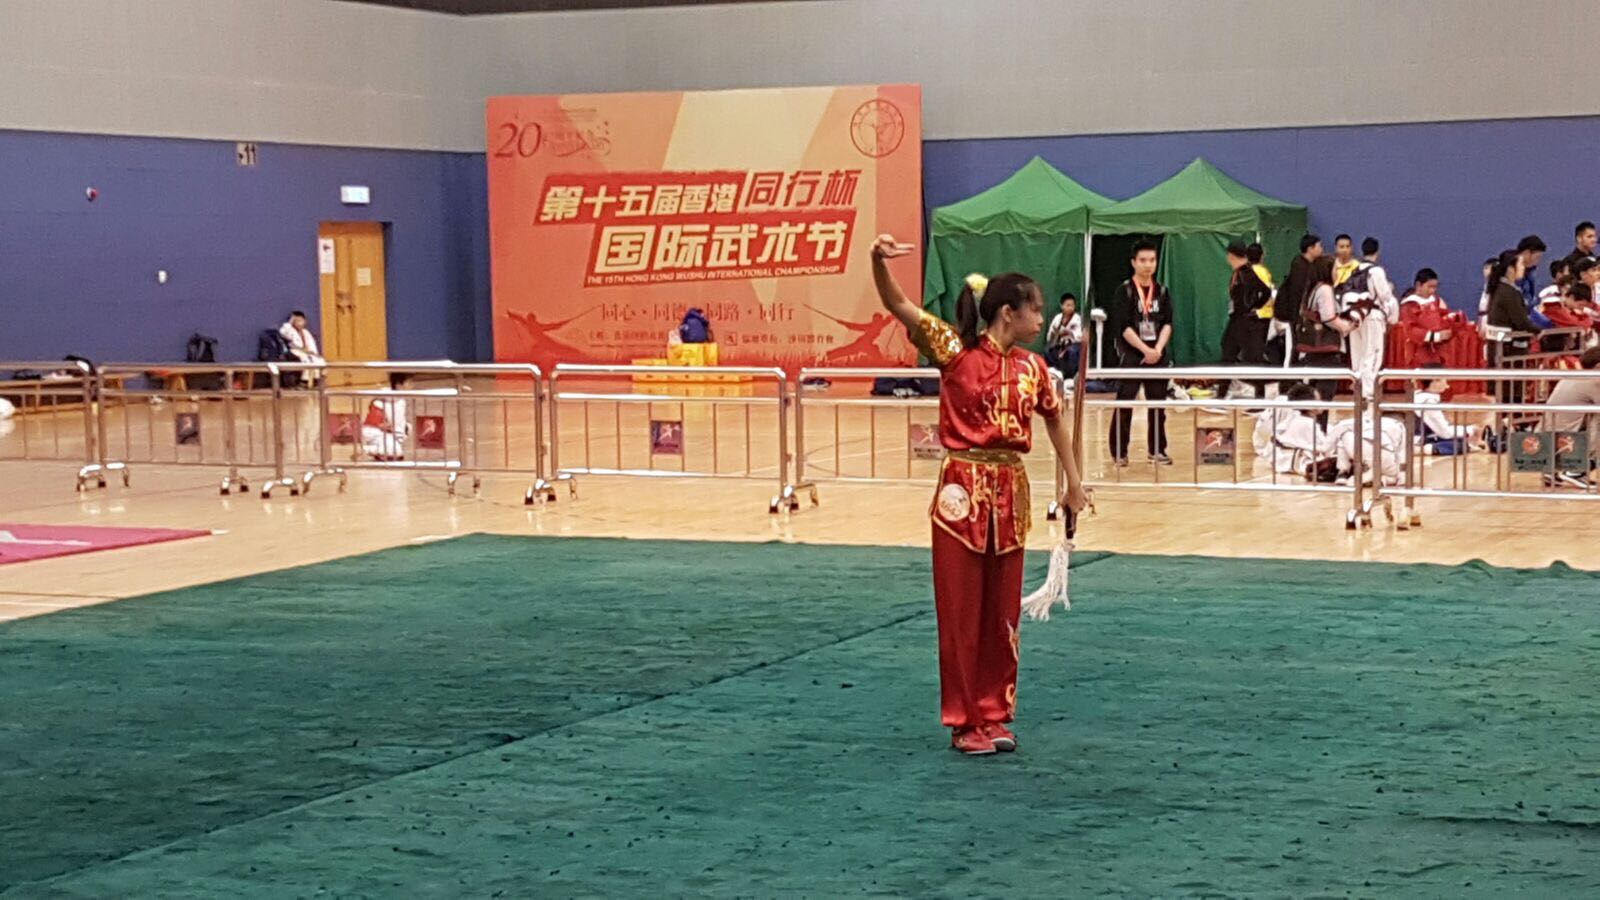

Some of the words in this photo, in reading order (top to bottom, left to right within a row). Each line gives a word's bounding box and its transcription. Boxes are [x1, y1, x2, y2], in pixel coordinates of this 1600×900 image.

[494, 122, 541, 158] 20
[594, 220, 848, 274] 国际武术节
[587, 275, 603, 284] THE
[624, 273, 649, 283] HONG
[650, 272, 675, 282] KONG
[676, 271, 707, 280] WUSHU
[707, 267, 773, 279] INTERNATIONAL
[773, 265, 840, 277] CHAMPIONSHIP
